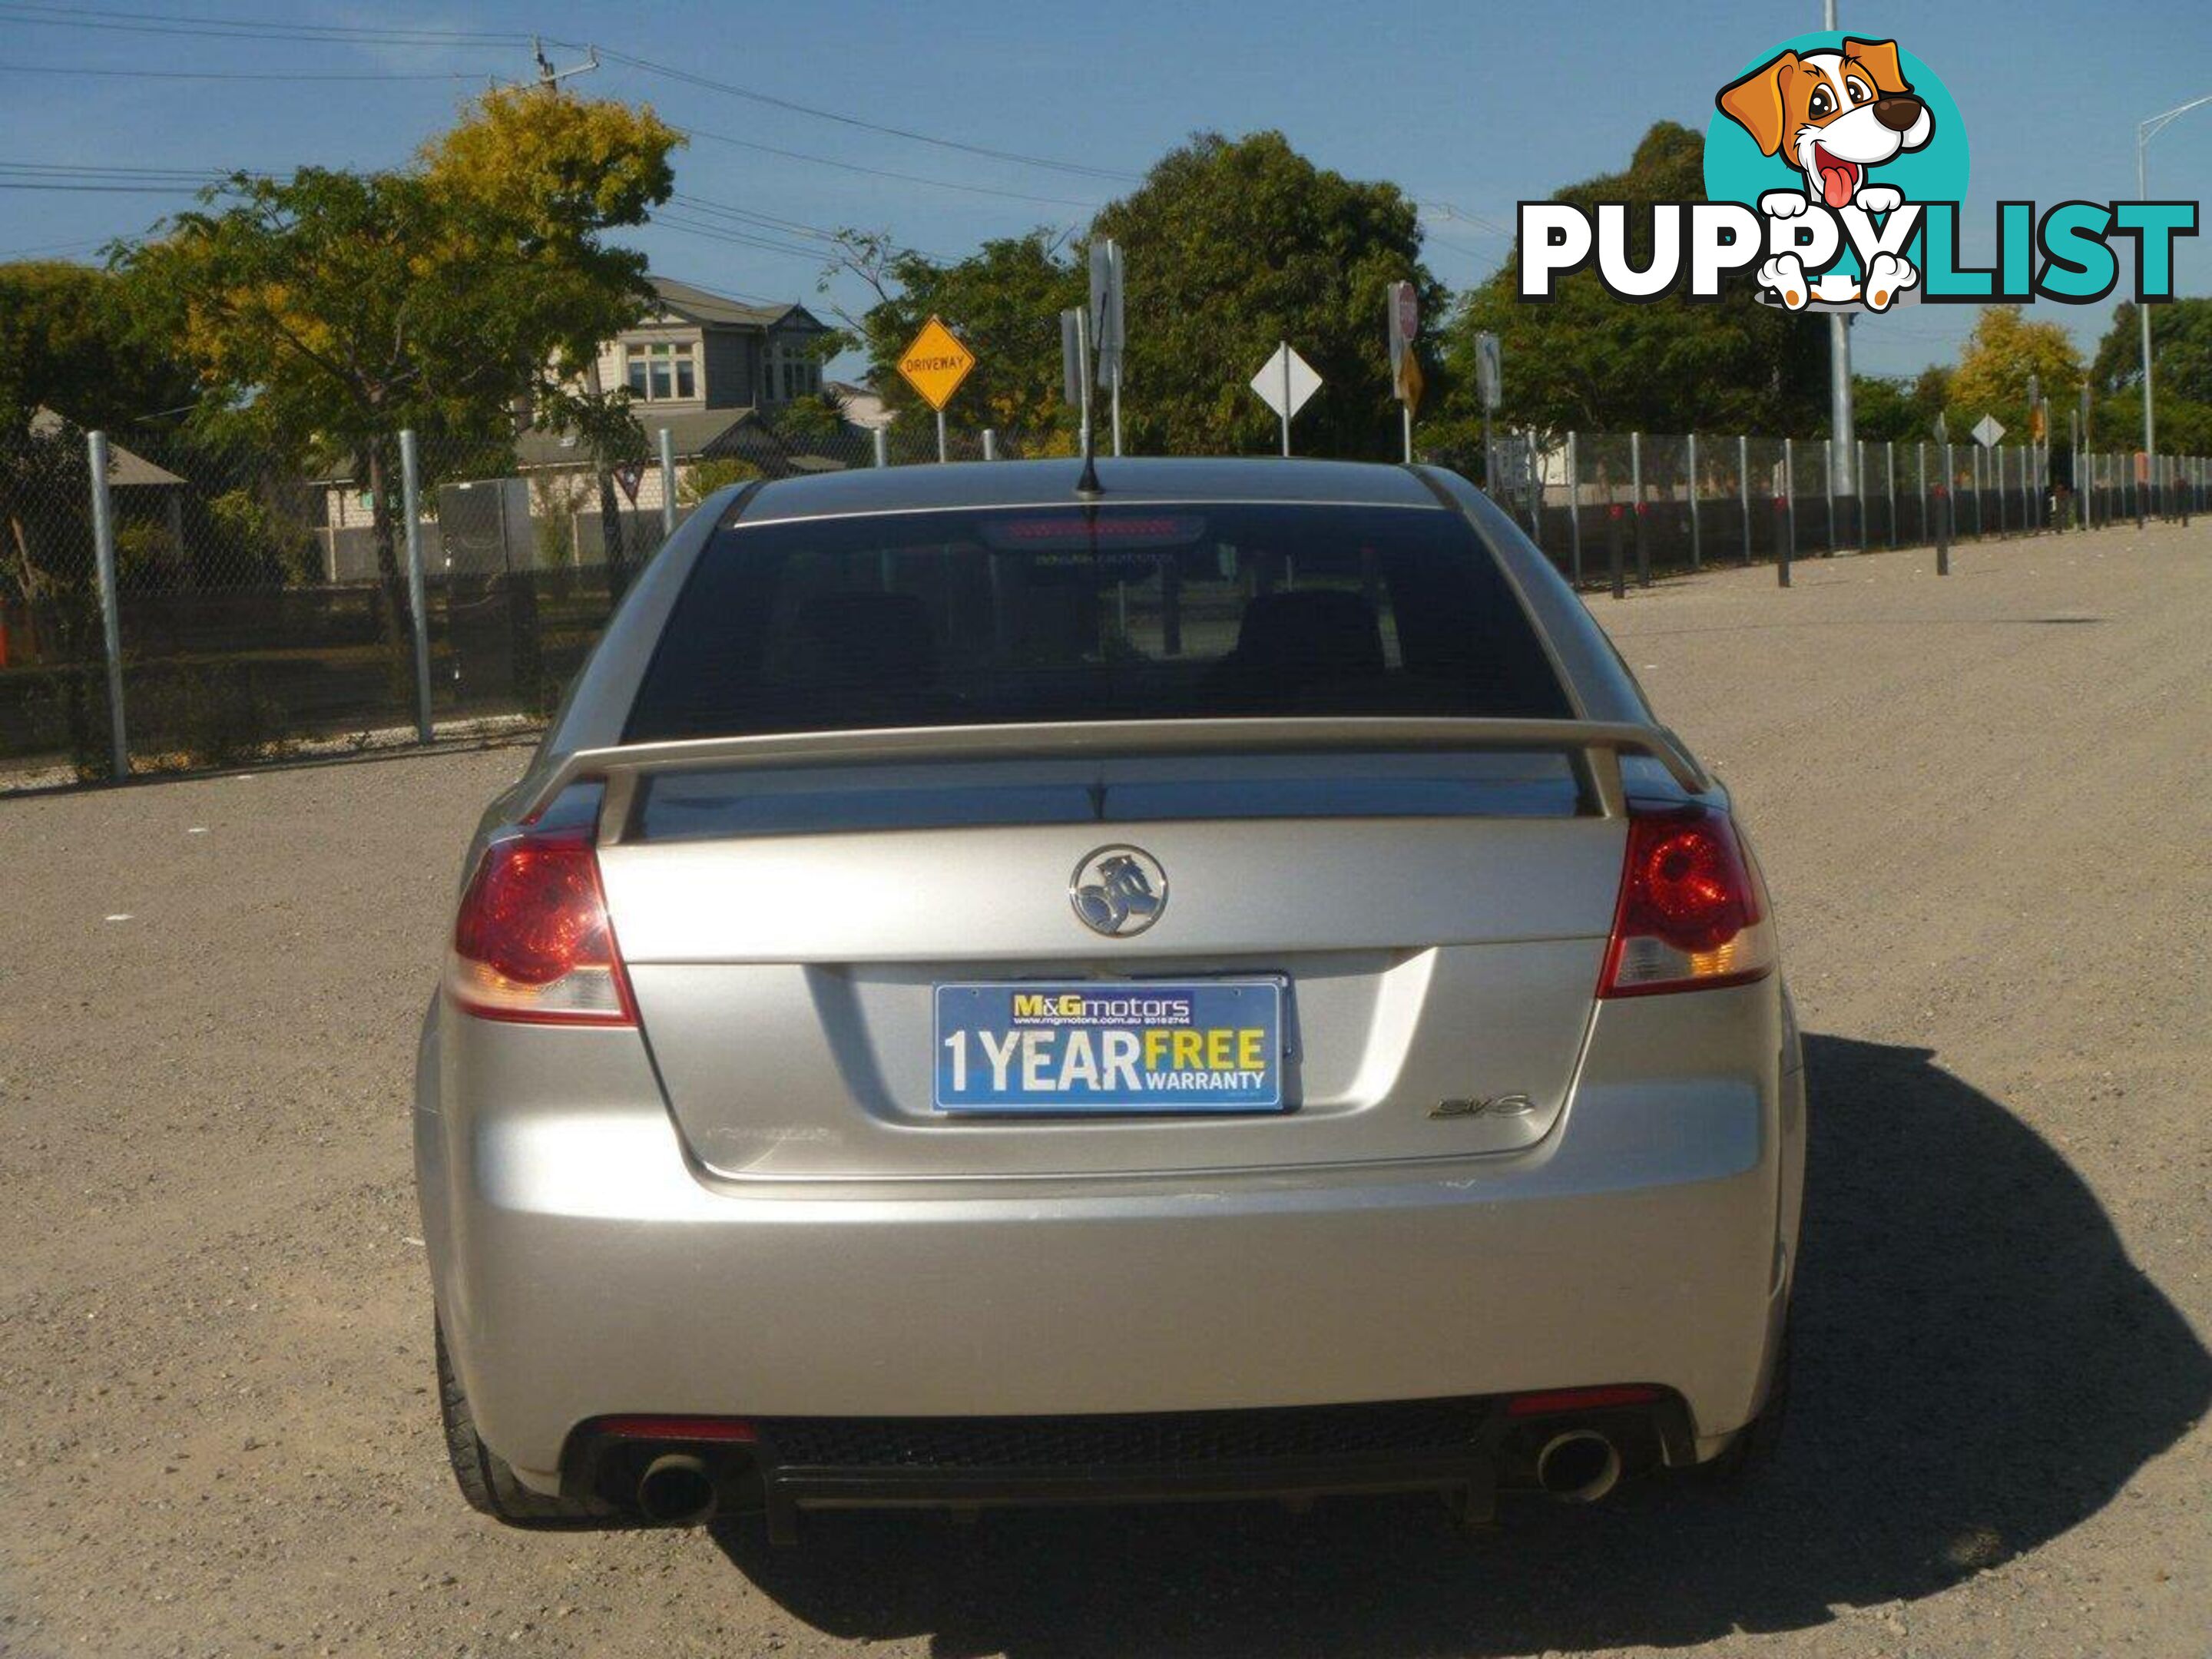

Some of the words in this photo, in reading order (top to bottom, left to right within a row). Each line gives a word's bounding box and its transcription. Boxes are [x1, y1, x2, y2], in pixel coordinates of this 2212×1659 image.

[906, 356, 964, 373] DRIVEWAY
[1014, 1017, 1141, 1026] www.mgmotors.com.au
[945, 1030, 966, 1091] 1
[979, 1030, 1143, 1091] YEAR
[1144, 1029, 1266, 1071] FREE
[1145, 1071, 1266, 1090] WARRANTY
